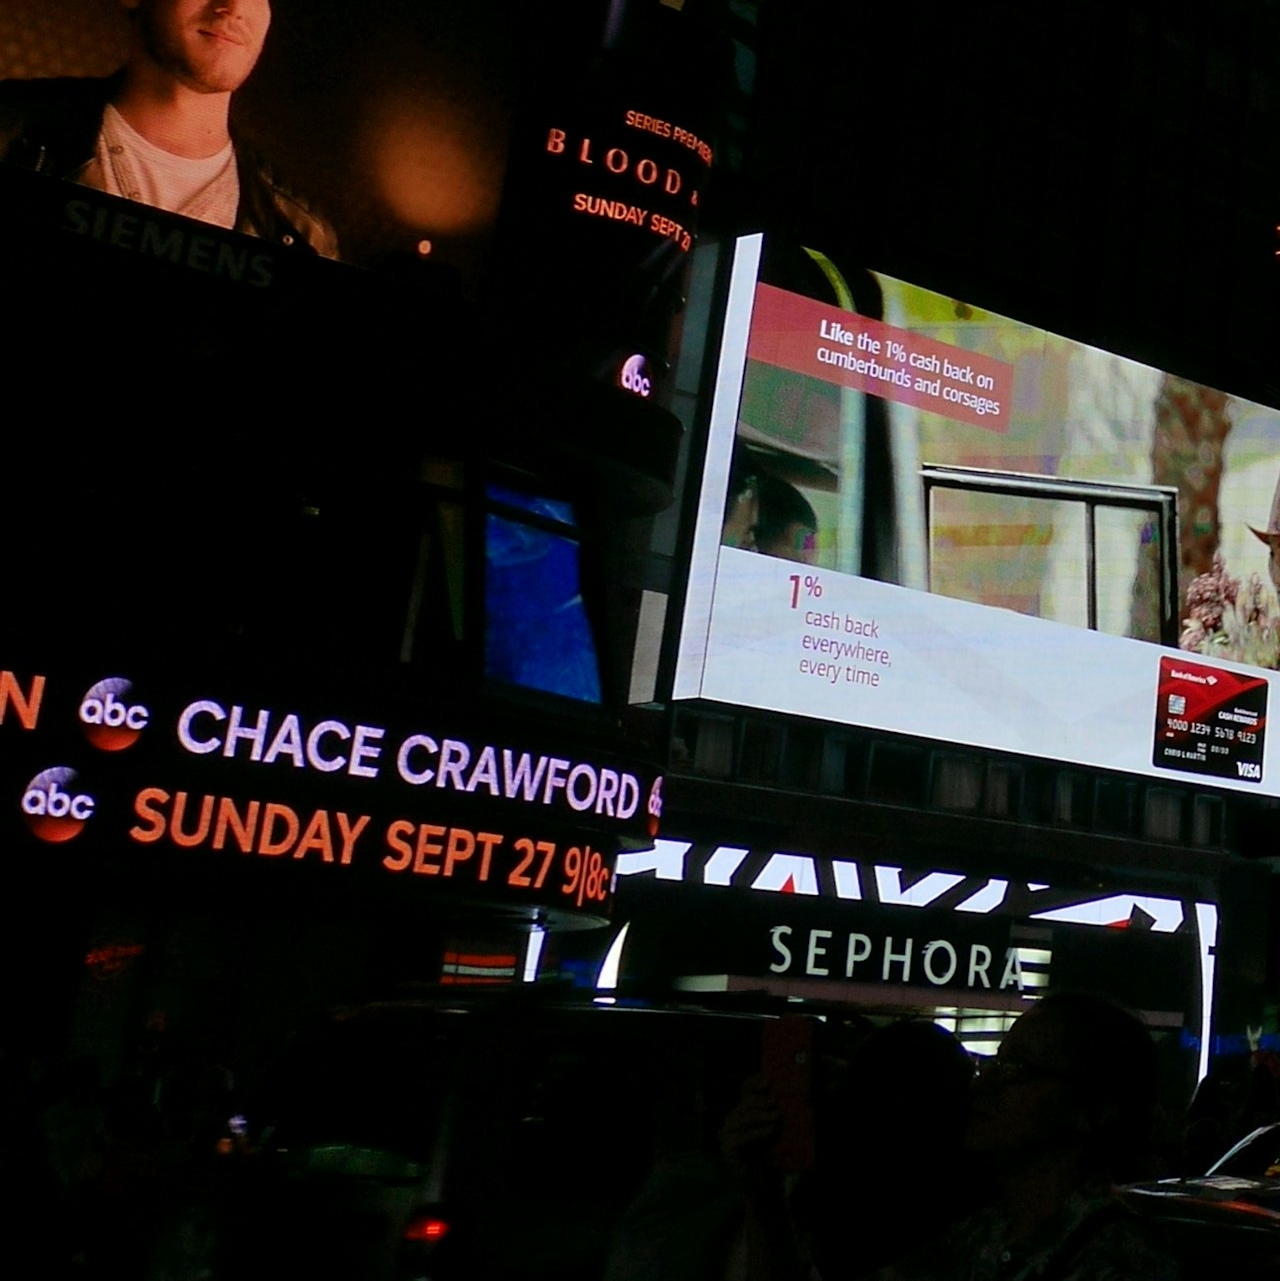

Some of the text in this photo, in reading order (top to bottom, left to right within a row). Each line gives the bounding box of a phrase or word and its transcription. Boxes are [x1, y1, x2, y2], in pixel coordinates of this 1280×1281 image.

[625, 109, 671, 139] SERIES
[547, 128, 681, 195] BLOOD
[574, 193, 648, 226] SUNDAY
[651, 213, 681, 242] SEPT
[63, 196, 274, 290] SIEMENS
[819, 319, 994, 391] Like the 1% cash back on
[621, 365, 651, 397] abc
[816, 347, 1000, 416] cumberbunds and corsages
[790, 574, 822, 609] 1%
[805, 610, 879, 639] cash back
[799, 658, 880, 687] every time
[802, 634, 892, 668] everywhere,
[79, 691, 149, 730] abc
[175, 696, 385, 779] CHACE
[396, 731, 641, 823] CRAWFORD
[1236, 761, 1260, 778] VISA
[22, 781, 95, 820] abc
[129, 785, 370, 870] SUNDAY
[382, 817, 502, 887] SEPT
[507, 838, 557, 892] 27
[769, 924, 1025, 992] SEPHORA
